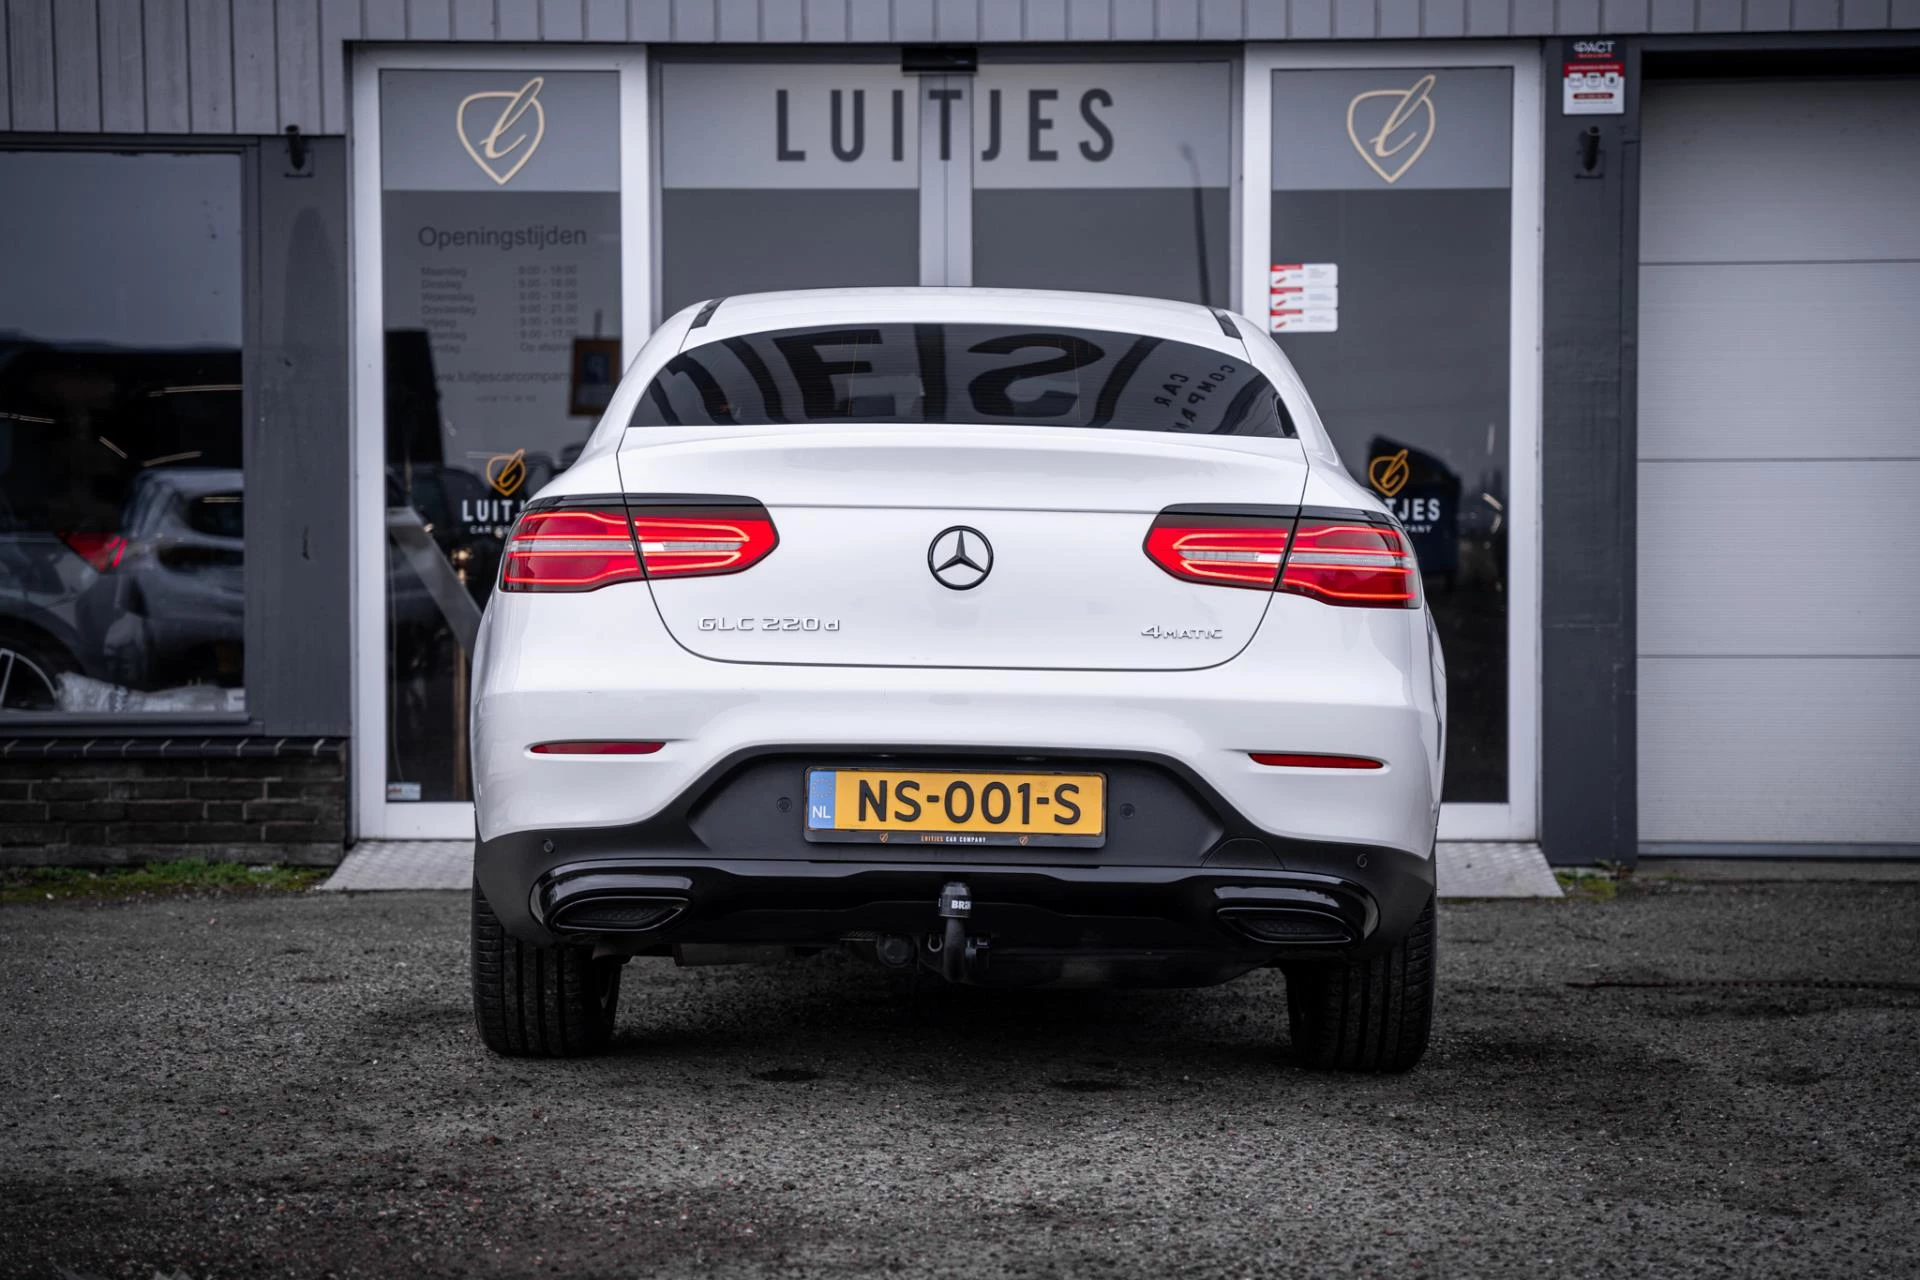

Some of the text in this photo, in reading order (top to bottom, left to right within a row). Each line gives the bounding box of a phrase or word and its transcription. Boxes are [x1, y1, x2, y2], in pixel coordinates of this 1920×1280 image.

[776, 88, 1114, 162] LUITJES
[418, 225, 587, 250] Openingstijden
[698, 617, 755, 631] GLC
[1141, 625, 1222, 640] 4MATIC
[812, 805, 831, 819] NL
[858, 779, 1081, 825] NS-001-S
